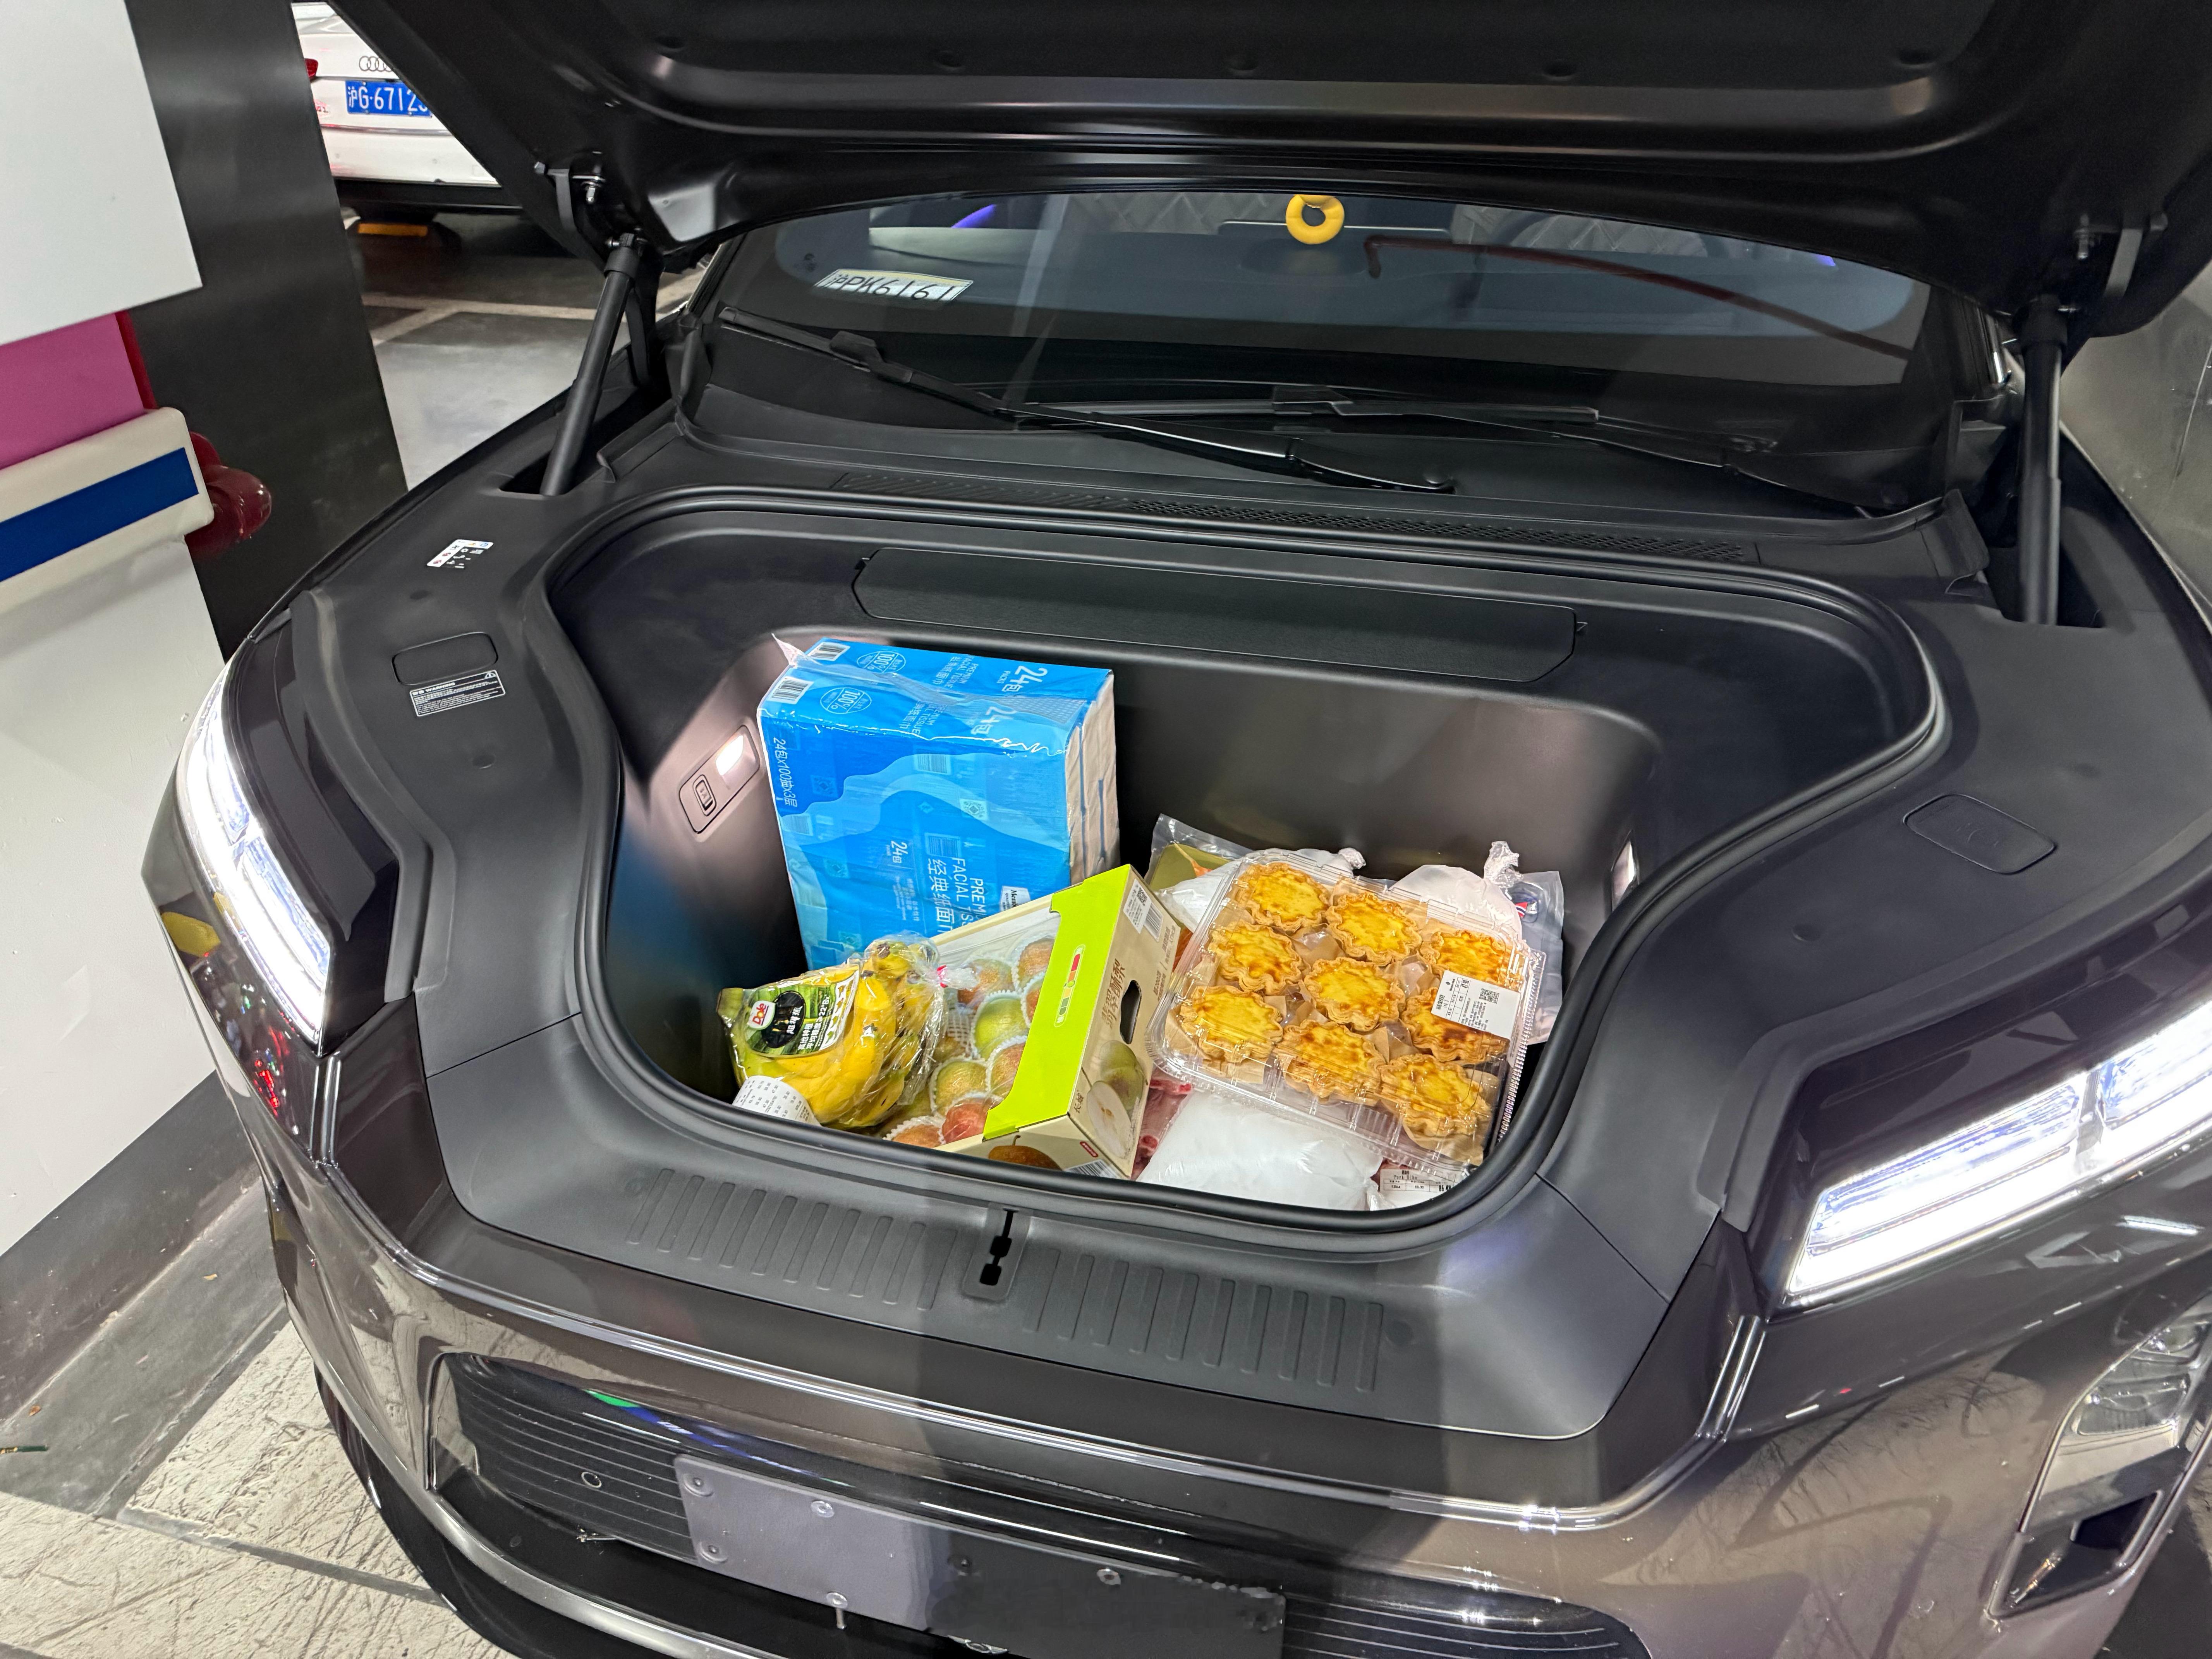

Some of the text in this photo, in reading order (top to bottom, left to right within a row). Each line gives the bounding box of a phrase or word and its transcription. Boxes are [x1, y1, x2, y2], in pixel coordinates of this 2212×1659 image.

[348, 86, 428, 112] 沪G·6712
[868, 653, 895, 673] 100%
[932, 656, 958, 685] 经典纸面巾
[960, 663, 979, 684] PREMIUM
[945, 672, 963, 688] TISSUE
[996, 670, 1011, 684] PACKS
[1001, 665, 1048, 692] 24包
[831, 690, 861, 710] 100%
[912, 712, 932, 735] TISSUE
[951, 857, 969, 902] FACIAL
[1101, 958, 1125, 1029] 翡翠酥梨
[752, 1003, 767, 1025] Dole
